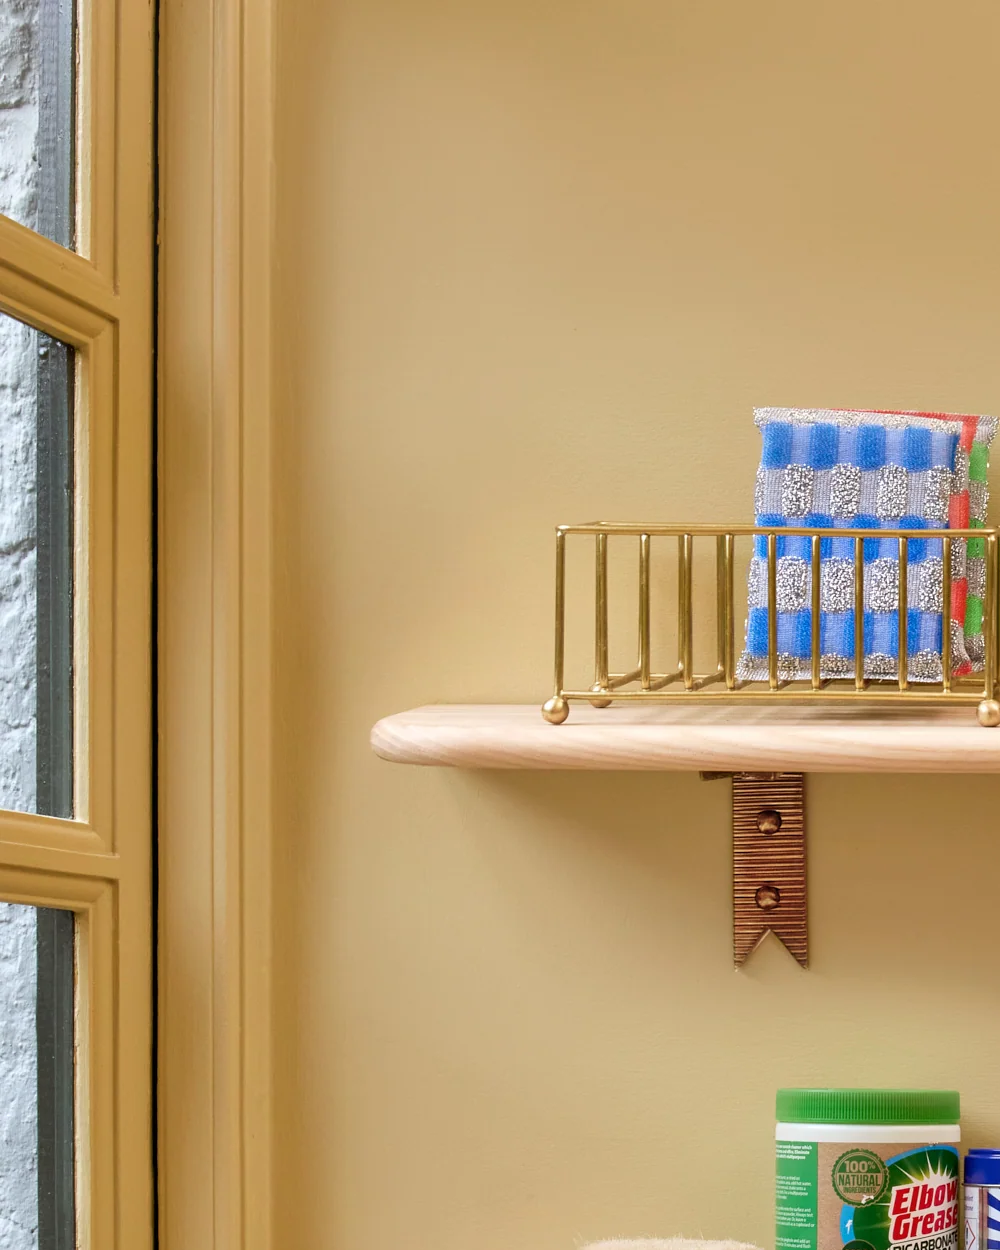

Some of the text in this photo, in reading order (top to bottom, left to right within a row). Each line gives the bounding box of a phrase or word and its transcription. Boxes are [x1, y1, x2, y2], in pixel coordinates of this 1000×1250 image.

[844, 1160, 876, 1172] 100%
[838, 1175, 880, 1186] NATURAL
[892, 1178, 958, 1215] Elbow
[892, 1204, 958, 1240] Grease
